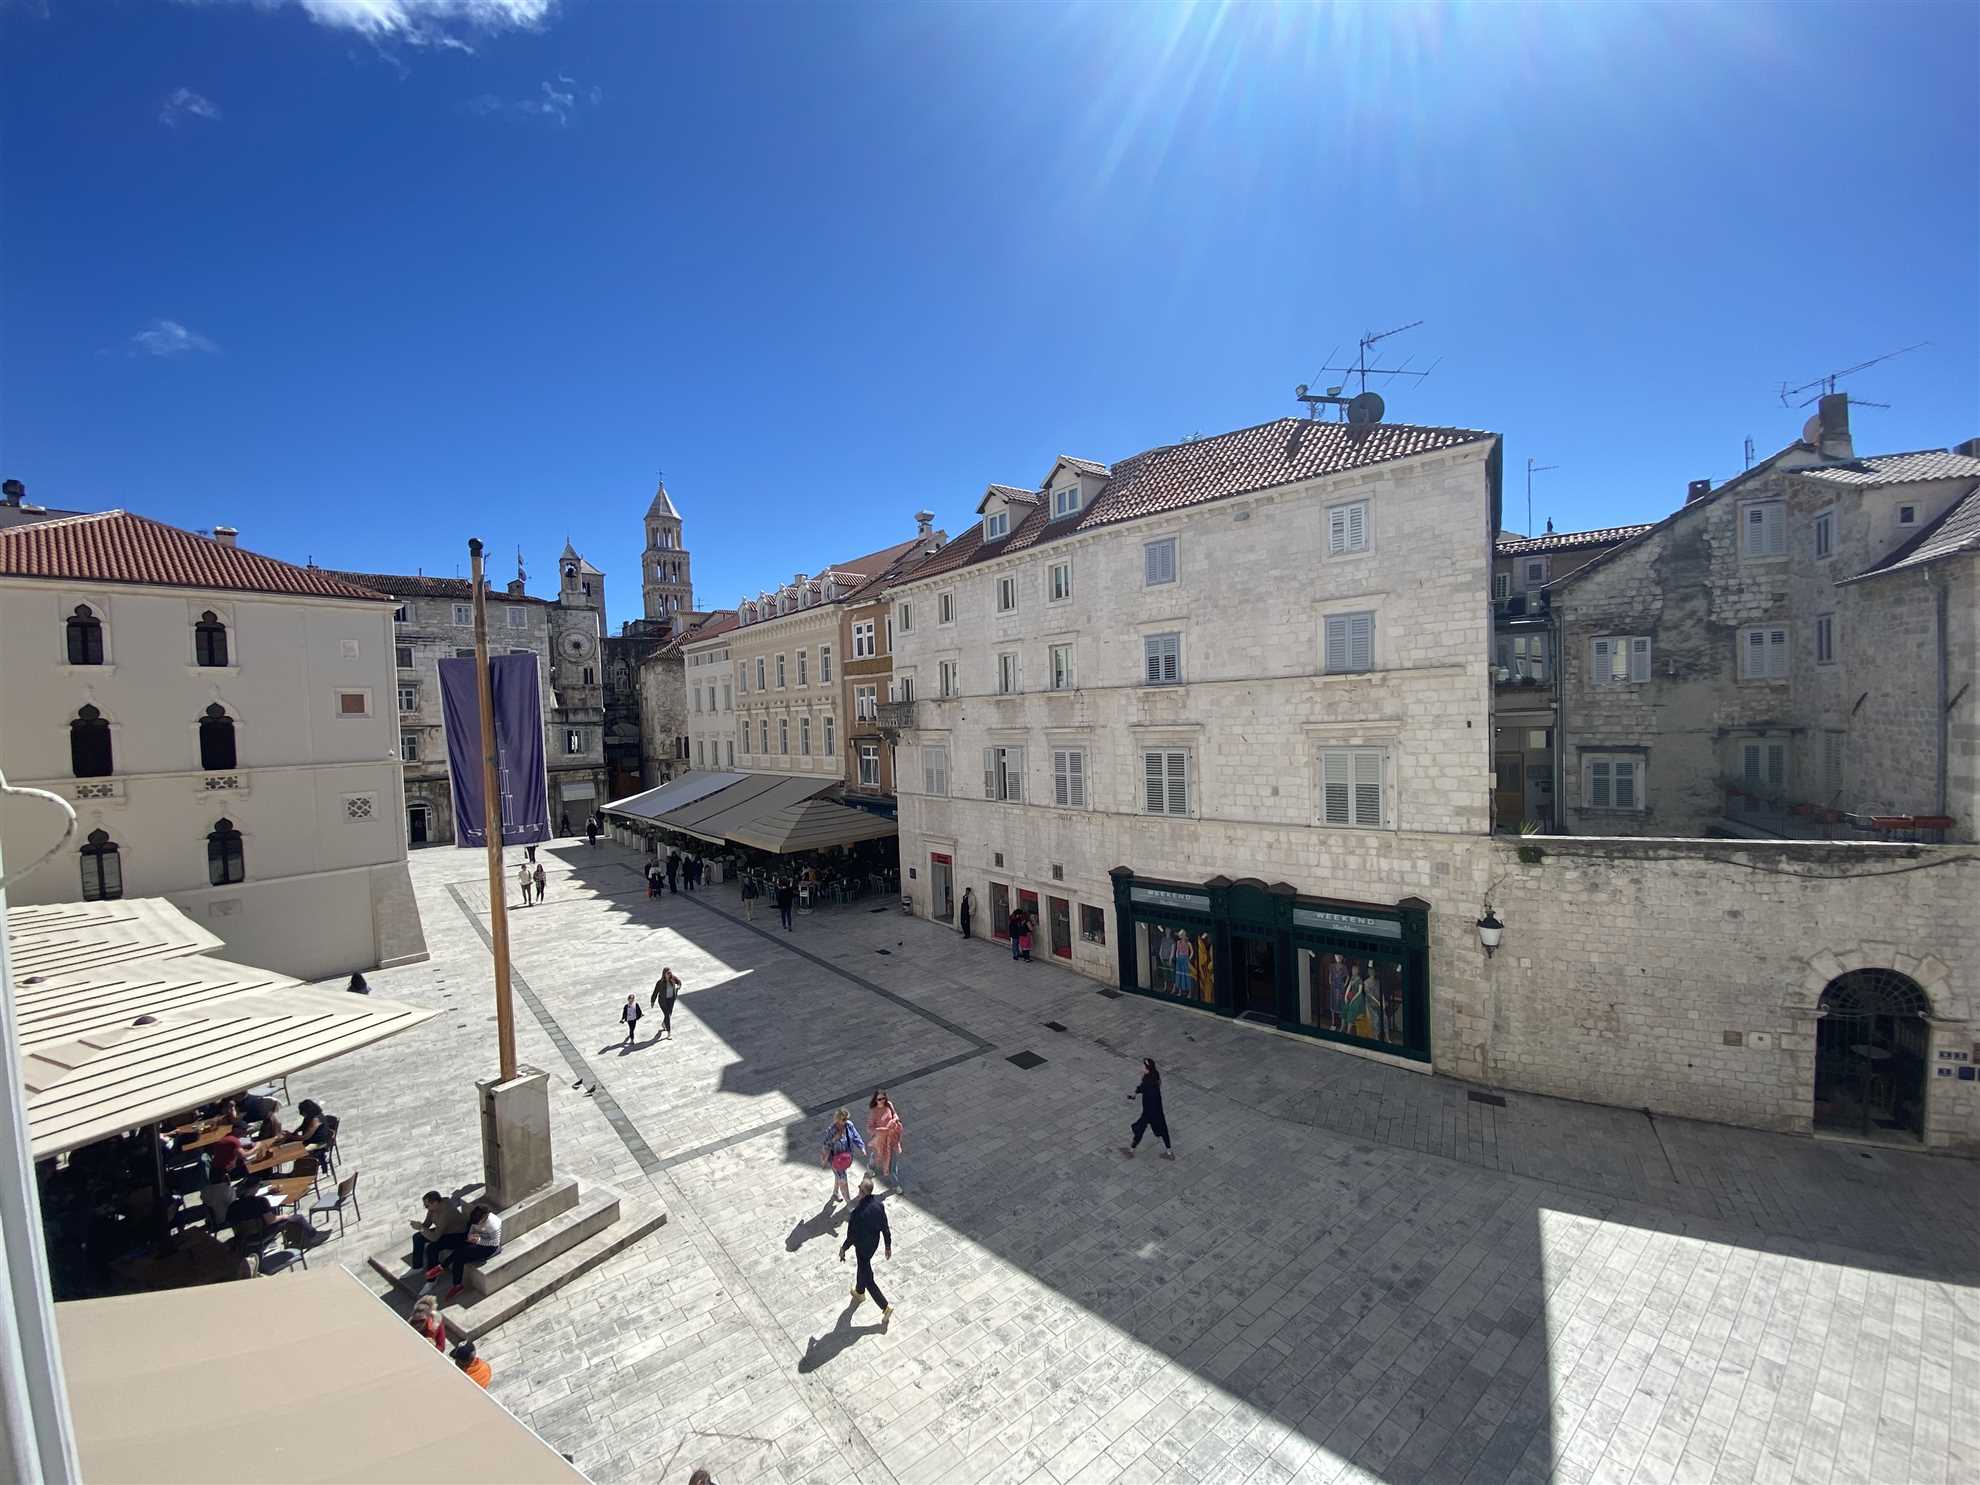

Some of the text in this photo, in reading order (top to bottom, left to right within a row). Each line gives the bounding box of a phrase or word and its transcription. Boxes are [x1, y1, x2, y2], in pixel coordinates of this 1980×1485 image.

[467, 823, 544, 838] SLIT
[1146, 889, 1191, 900] WEEKEND
[1315, 912, 1375, 925] WEEKEND
